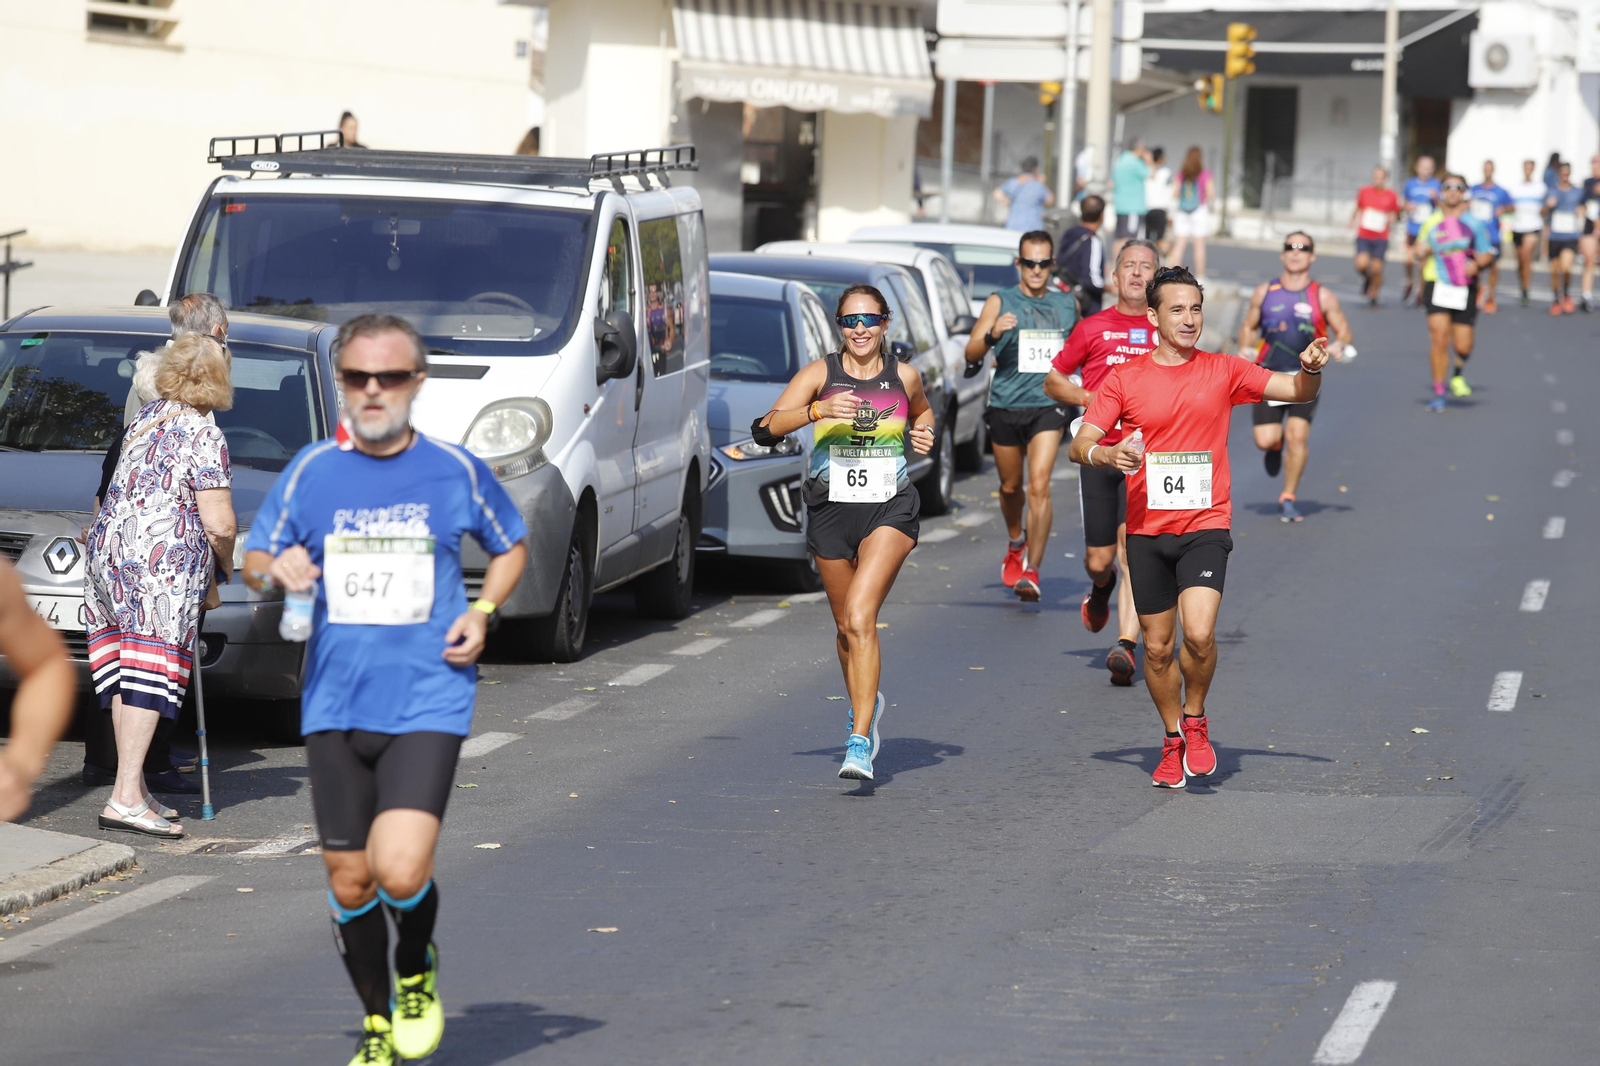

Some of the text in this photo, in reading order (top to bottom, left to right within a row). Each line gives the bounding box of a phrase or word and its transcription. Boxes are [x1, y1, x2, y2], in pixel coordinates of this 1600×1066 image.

[252, 162, 279, 170] CRUZ
[1028, 347, 1052, 361] 314
[843, 449, 864, 457] VUELTA
[865, 449, 870, 457] A
[871, 448, 892, 457] HUELVA
[1158, 455, 1181, 464] VUELTA
[1181, 455, 1187, 464] A
[1187, 454, 1209, 464] HUELVA
[846, 468, 868, 487] 65
[1163, 475, 1186, 494] 64
[333, 502, 431, 526] RUNNERS
[345, 572, 393, 597] 647
